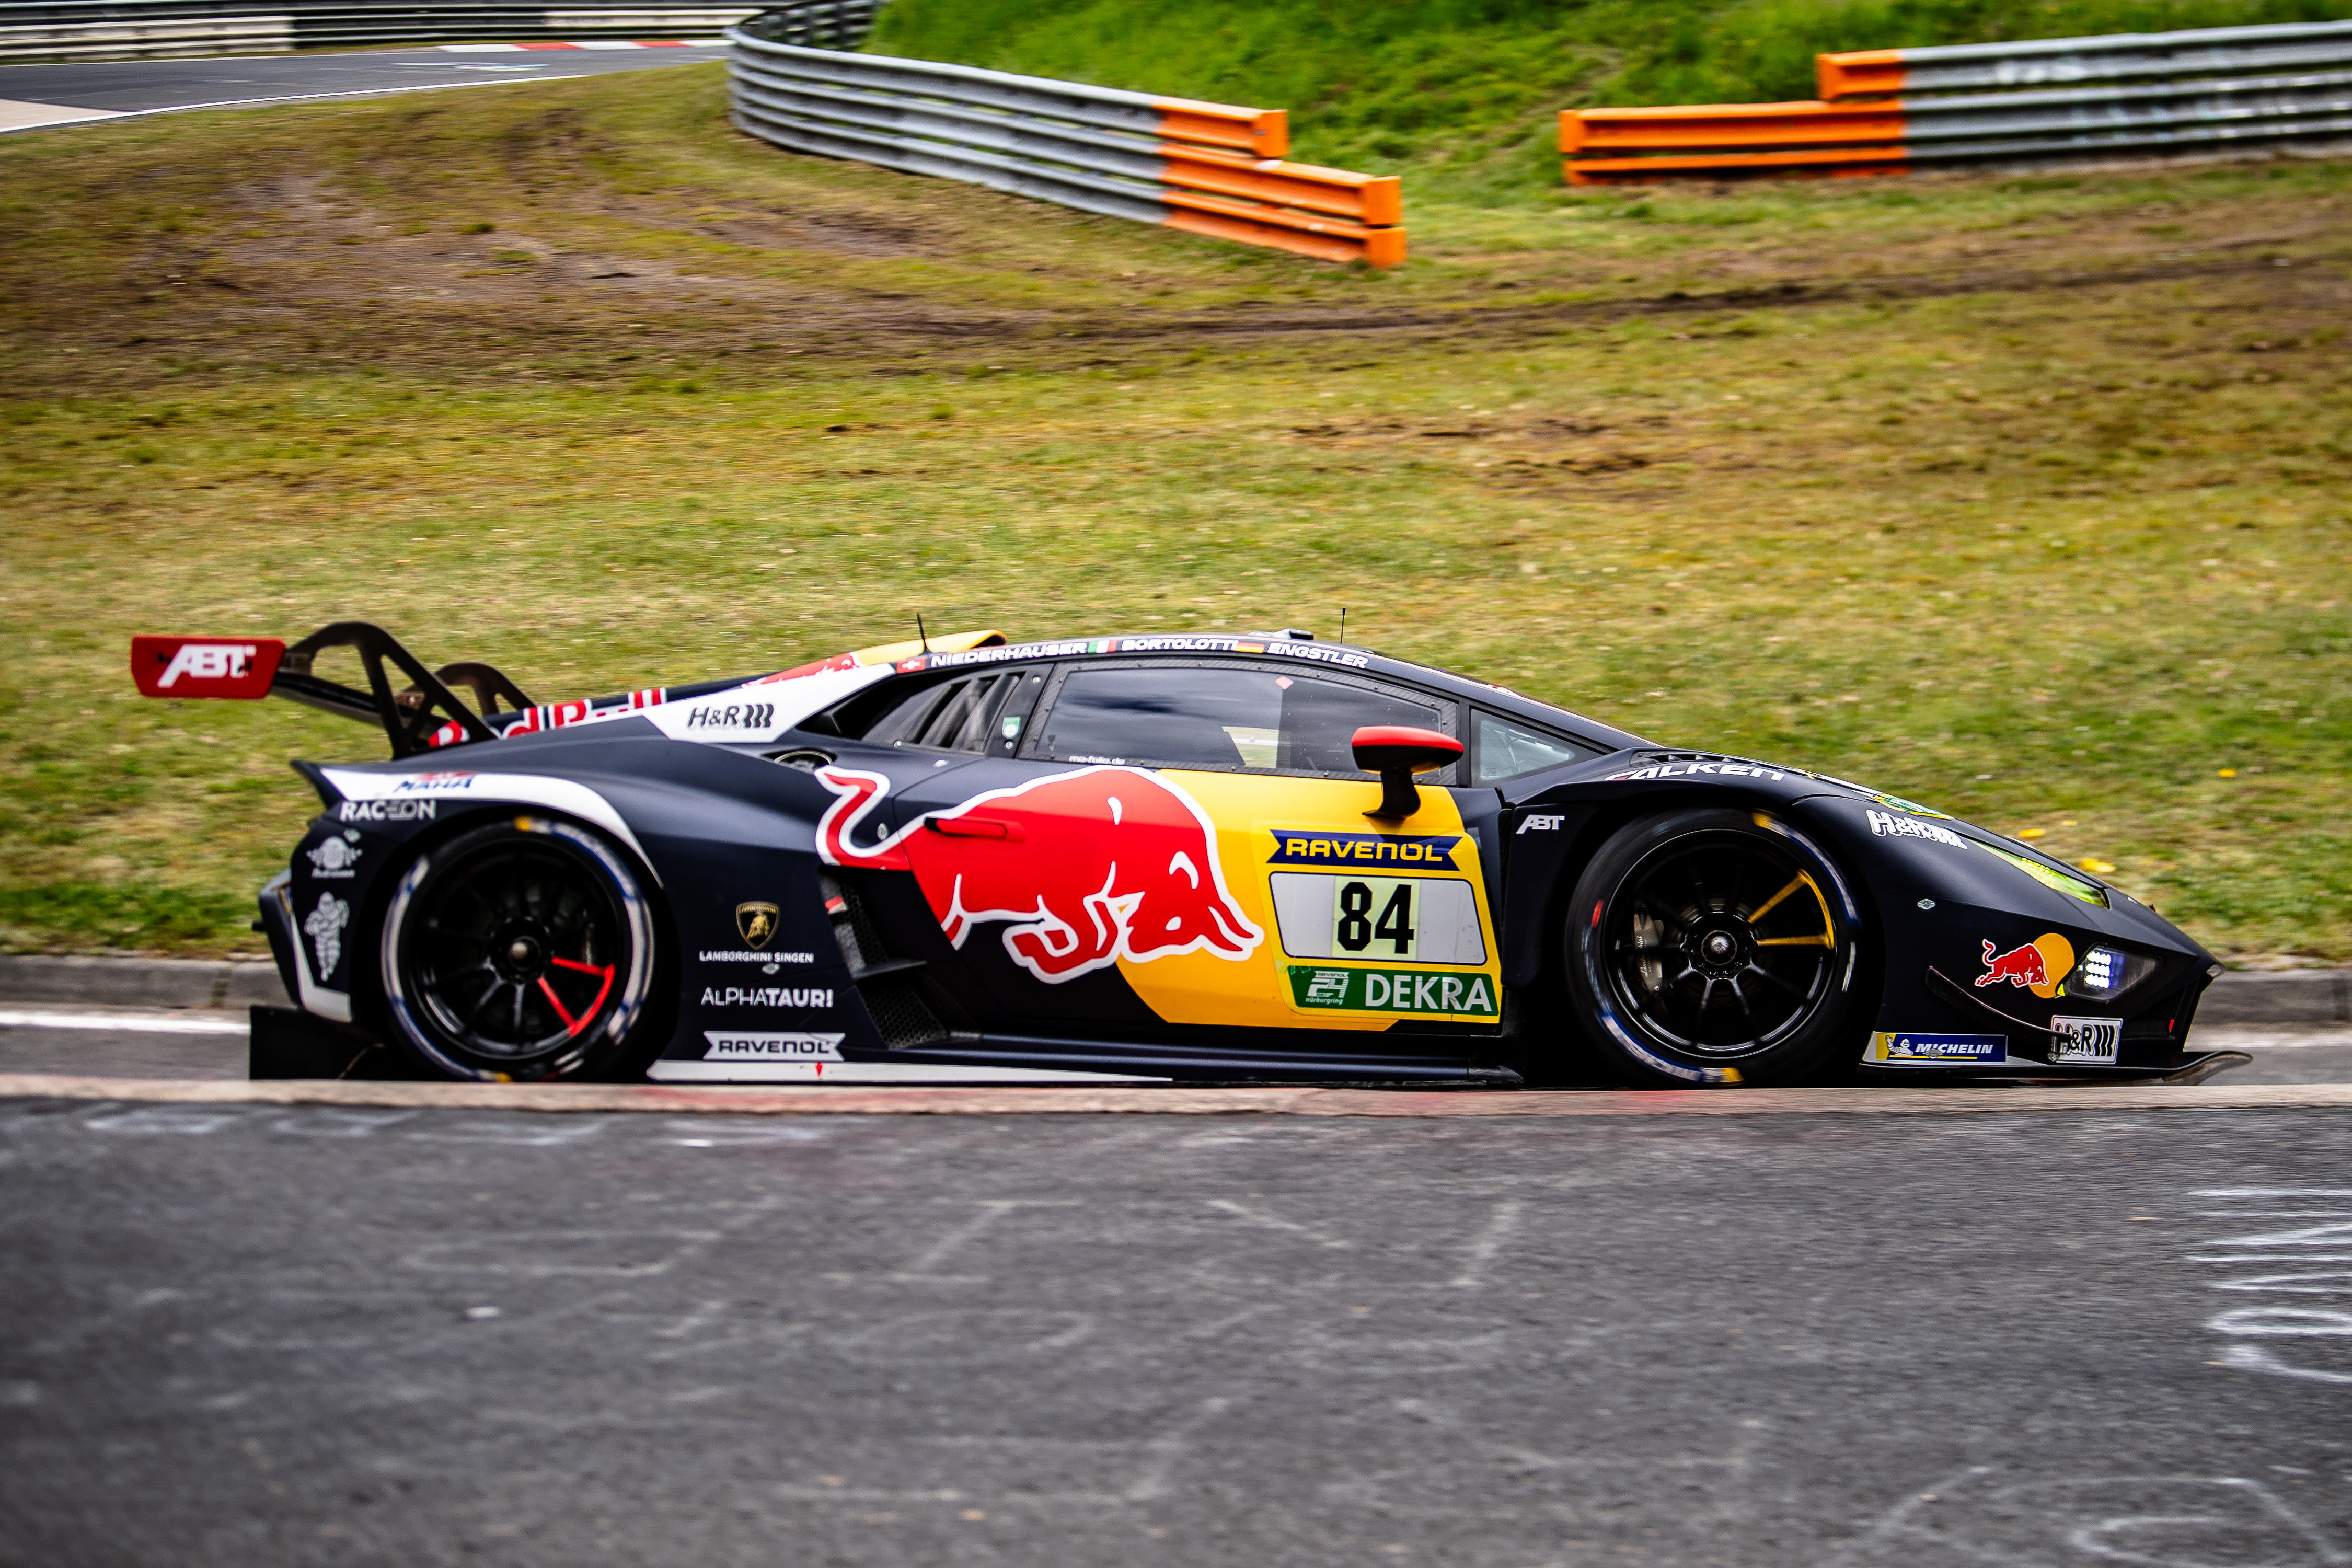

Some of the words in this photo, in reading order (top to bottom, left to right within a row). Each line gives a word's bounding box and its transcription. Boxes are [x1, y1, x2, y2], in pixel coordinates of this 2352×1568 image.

[931, 642, 1087, 667] NIEDERHAUSER
[1121, 638, 1239, 651] BORTOLOTTI
[1267, 643, 1369, 668] ENGSTLER
[157, 644, 257, 688] ABT
[688, 705, 741, 729] H&R
[1604, 764, 1785, 781] FALKEN
[1516, 815, 1565, 834] ABT
[1866, 810, 1930, 840] H&R
[1286, 838, 1443, 862] RAVENOL
[1338, 882, 1414, 954] 84
[699, 950, 773, 963] LAMBORGHINI
[774, 952, 814, 963] SINGEN
[701, 987, 834, 1008] ALPHATAURI
[1305, 997, 1343, 1005] nürburgring
[1365, 973, 1492, 1012] DEKRA
[718, 1040, 831, 1054] RAVENOL
[1915, 1043, 1993, 1054] MICHELIN
